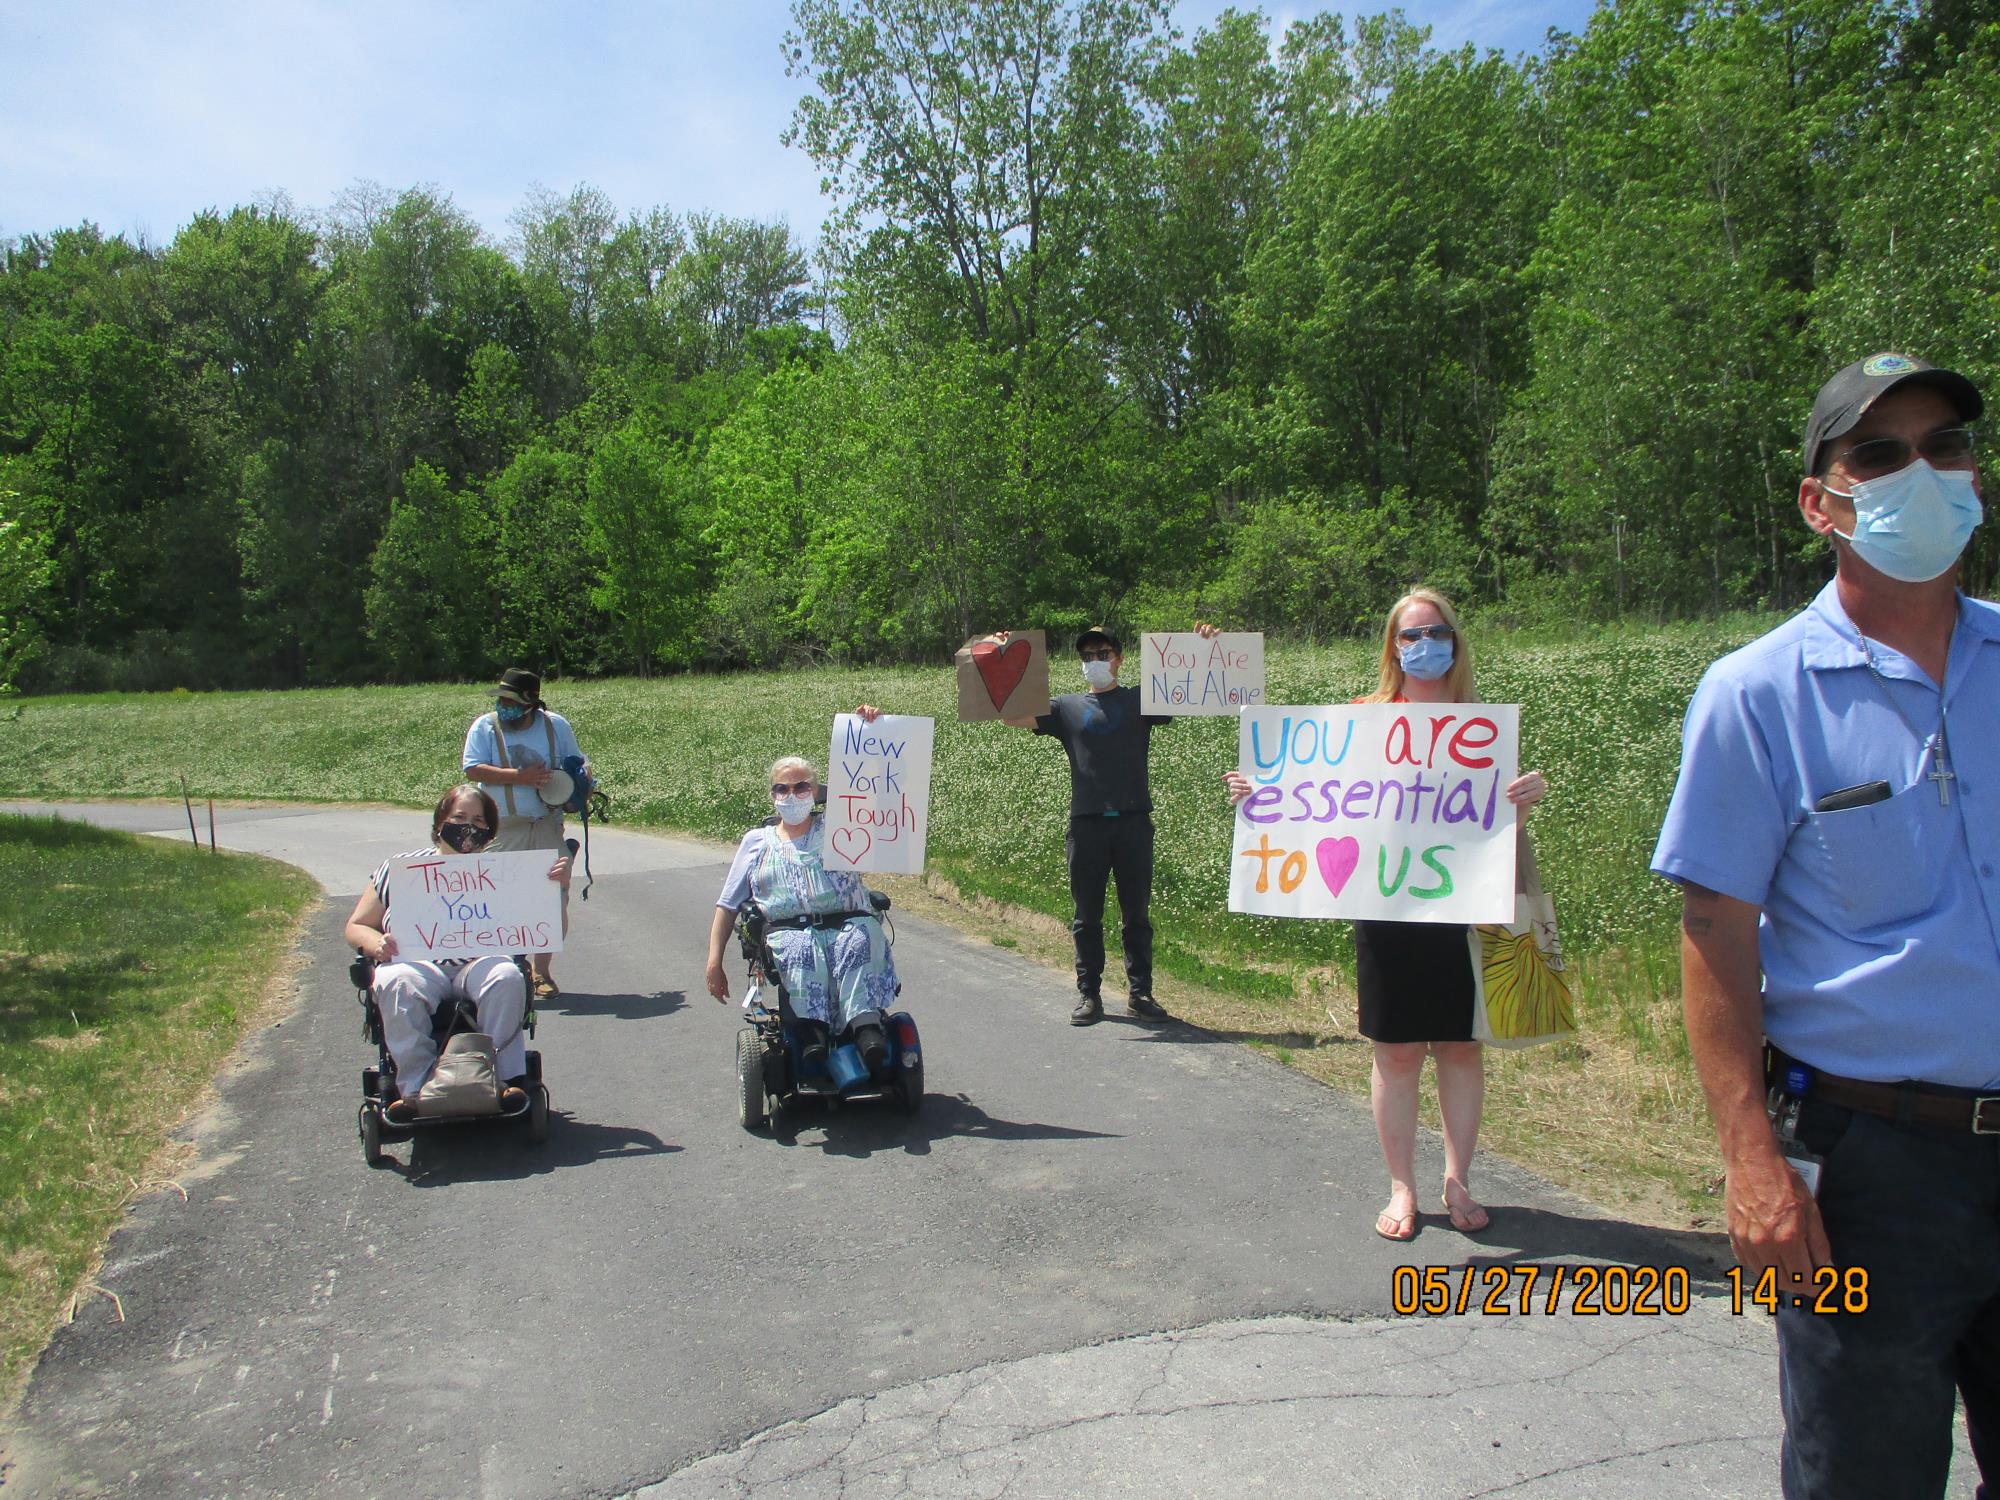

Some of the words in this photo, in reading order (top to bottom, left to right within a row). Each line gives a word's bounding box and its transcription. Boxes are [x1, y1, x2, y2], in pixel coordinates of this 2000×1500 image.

[1150, 636, 1196, 669] You
[1208, 640, 1249, 669] Are
[1152, 670, 1199, 705] Not
[1201, 670, 1260, 707] Alone
[845, 719, 906, 759] New
[1385, 715, 1499, 769] are
[842, 761, 900, 794] York
[838, 793, 915, 842] Tough
[1242, 768, 1500, 831] essential
[406, 859, 496, 893] Thank
[1240, 833, 1308, 894] to
[441, 894, 493, 921] You
[415, 921, 551, 950] Veterans
